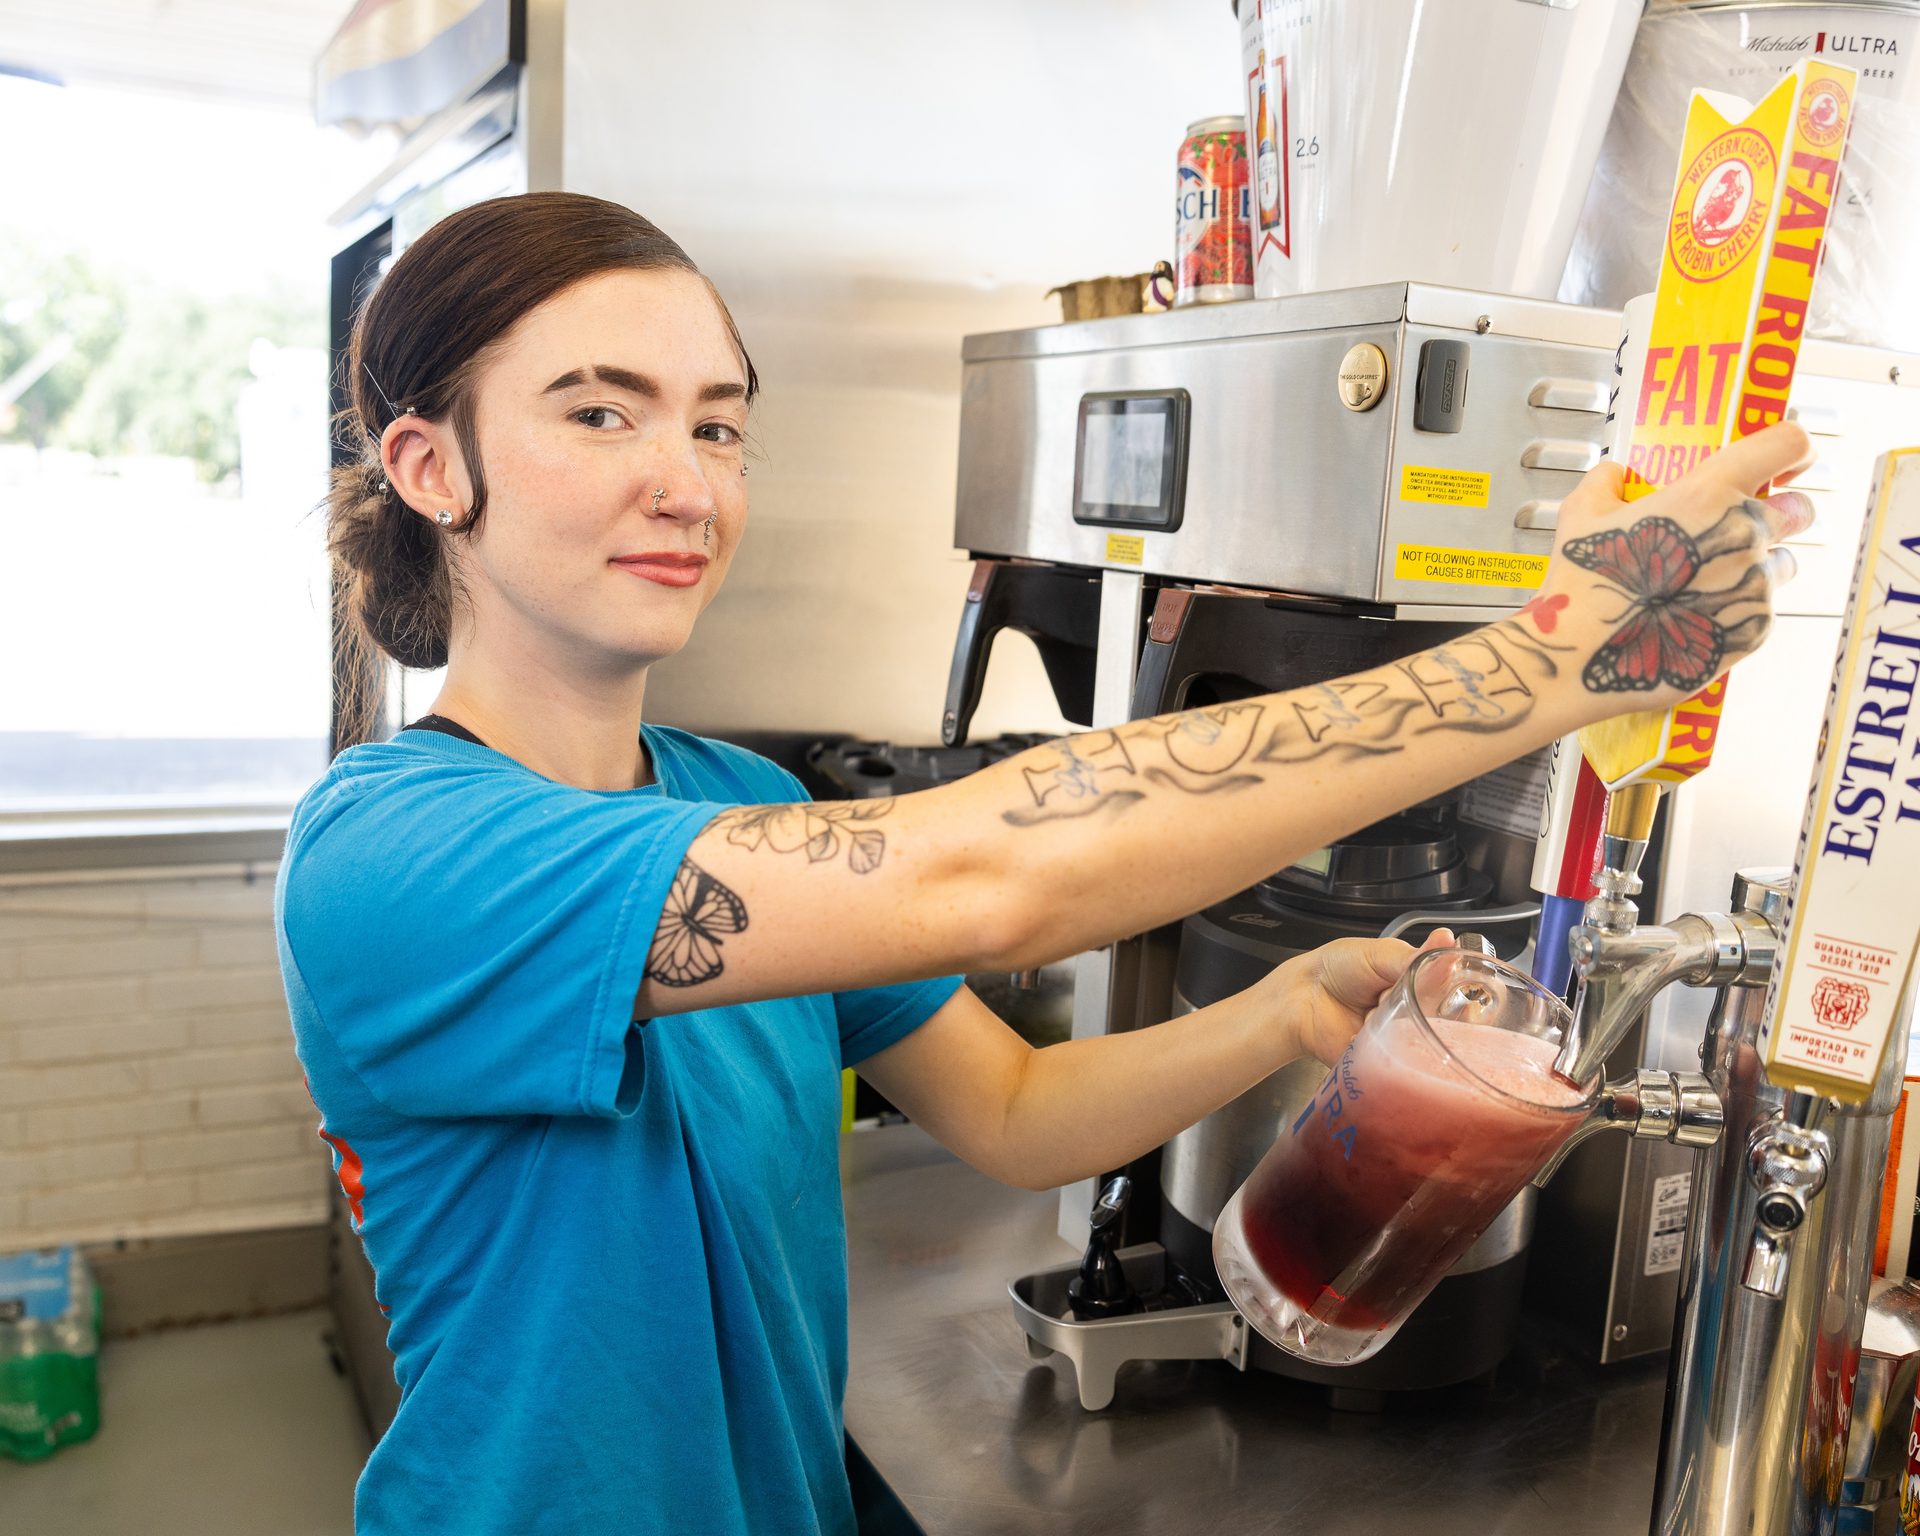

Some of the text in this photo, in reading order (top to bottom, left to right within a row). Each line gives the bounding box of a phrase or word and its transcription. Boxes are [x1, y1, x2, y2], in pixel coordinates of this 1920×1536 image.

[1746, 35, 1898, 56] Michelob ULTRA
[1863, 68, 1895, 79] BEER
[1296, 136, 1319, 158] 2.6
[1689, 136, 1770, 185] WESTERN CIDER
[1773, 151, 1839, 278] FAT
[1675, 199, 1767, 272] FAT ROBIN CHERRY
[1737, 292, 1809, 438] ROB
[1635, 342, 1743, 426] FAT
[1402, 550, 1543, 572] NOT FOLOWING INSTRUCTIONS
[1425, 565, 1522, 583] CAUSES BITTERNESS
[1814, 941, 1892, 966] GUADALAJARA
[1820, 954, 1853, 968] DESDE
[1790, 1033, 1865, 1058] IMPORTADA DE
[1320, 1062, 1357, 1162] TRA
